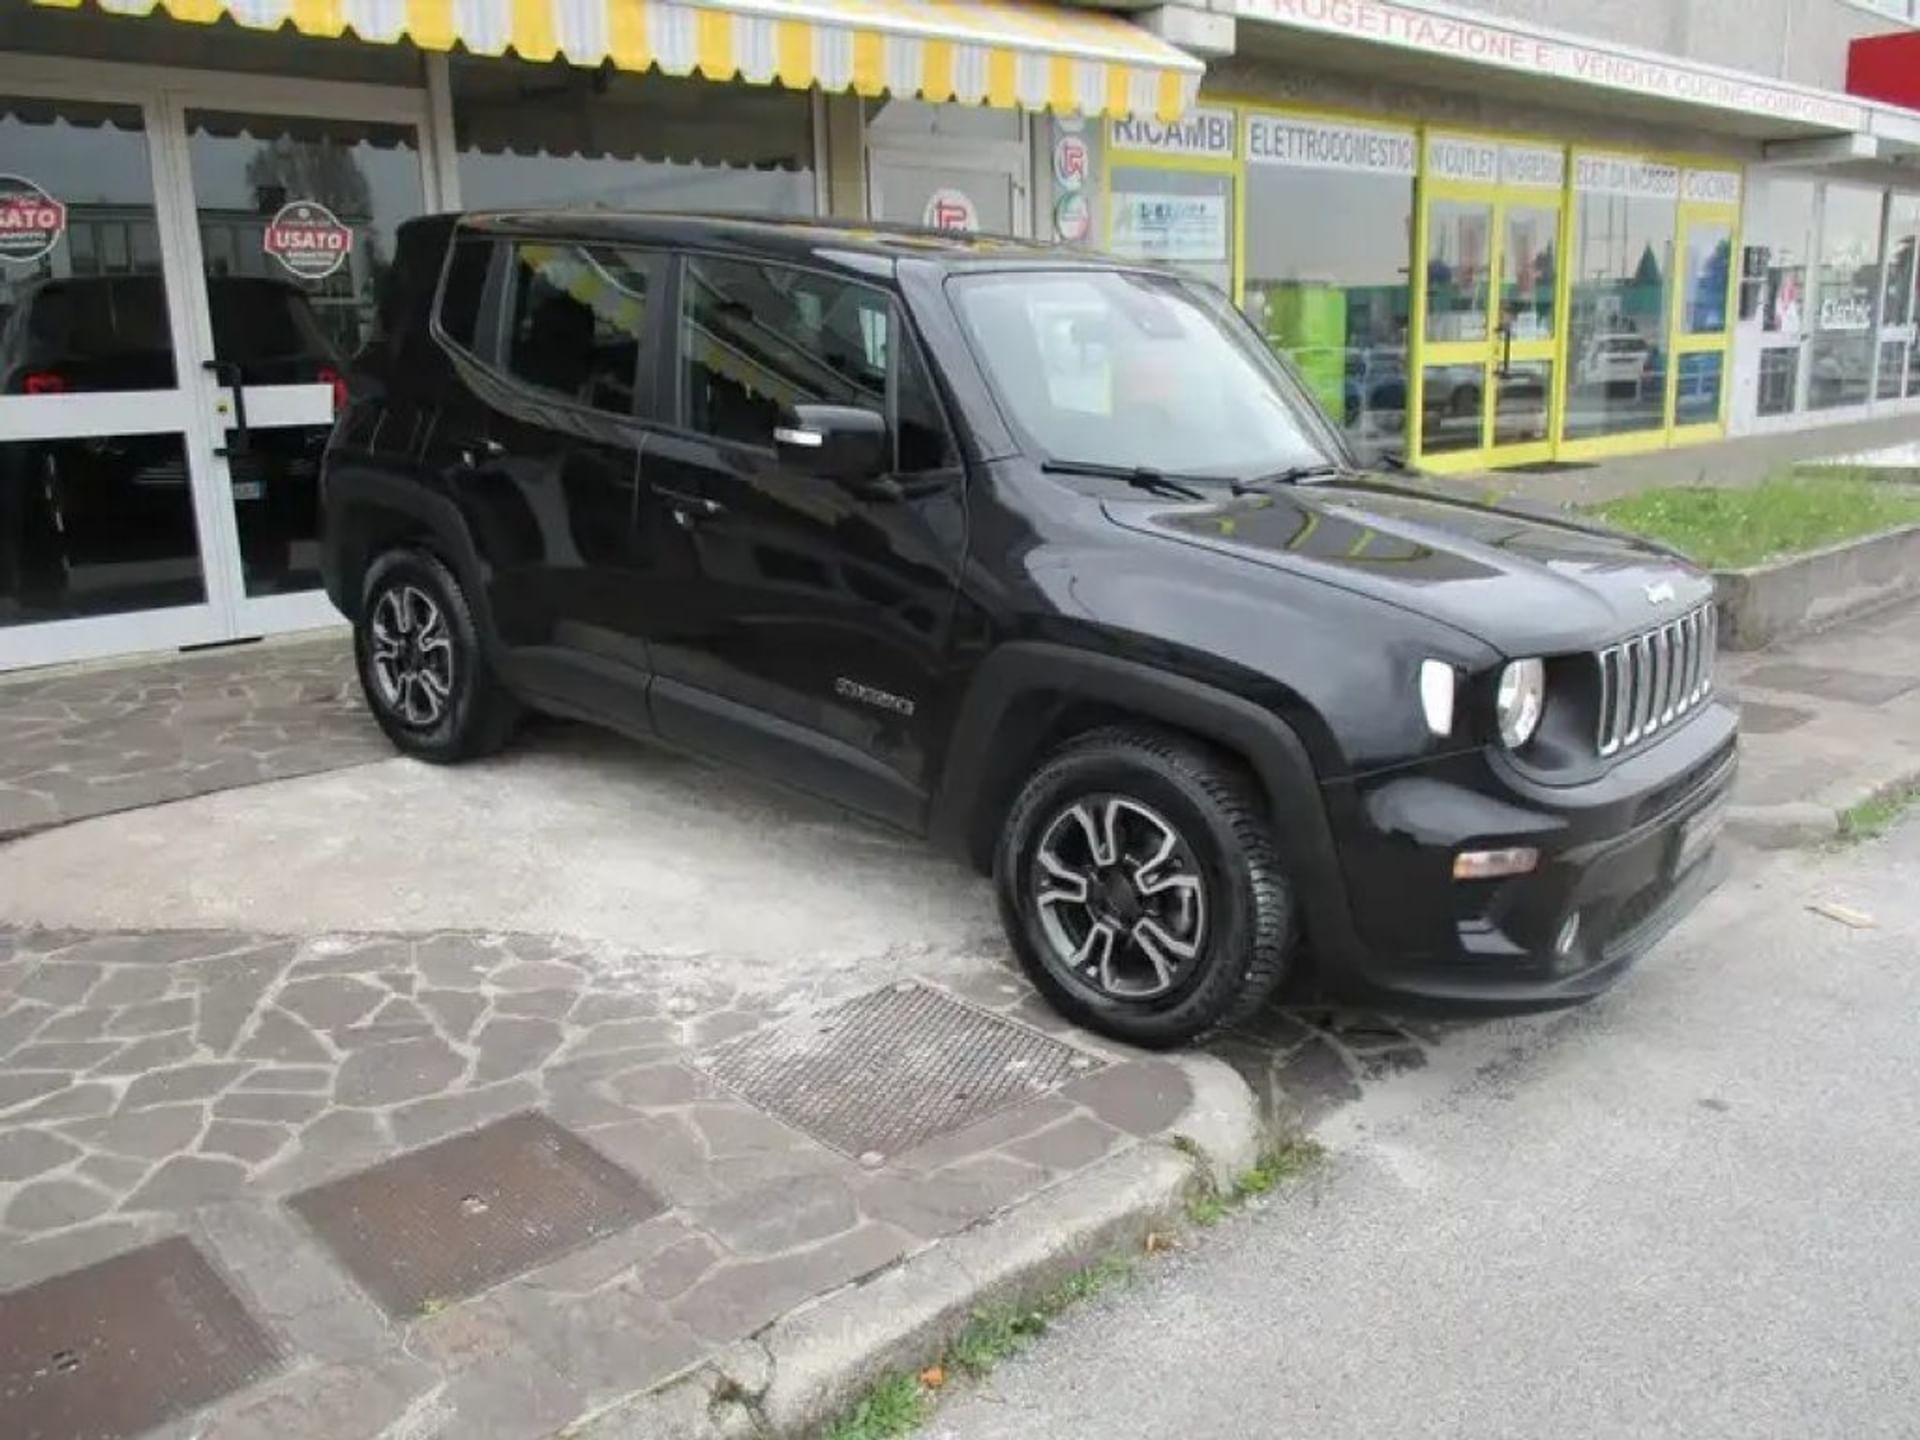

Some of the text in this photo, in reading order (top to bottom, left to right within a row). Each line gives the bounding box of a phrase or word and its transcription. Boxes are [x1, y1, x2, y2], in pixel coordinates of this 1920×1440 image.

[1247, 0, 1525, 61] ROGETTAZIONE
[1114, 111, 1232, 150] RICAMBI
[276, 231, 342, 249] USATO
